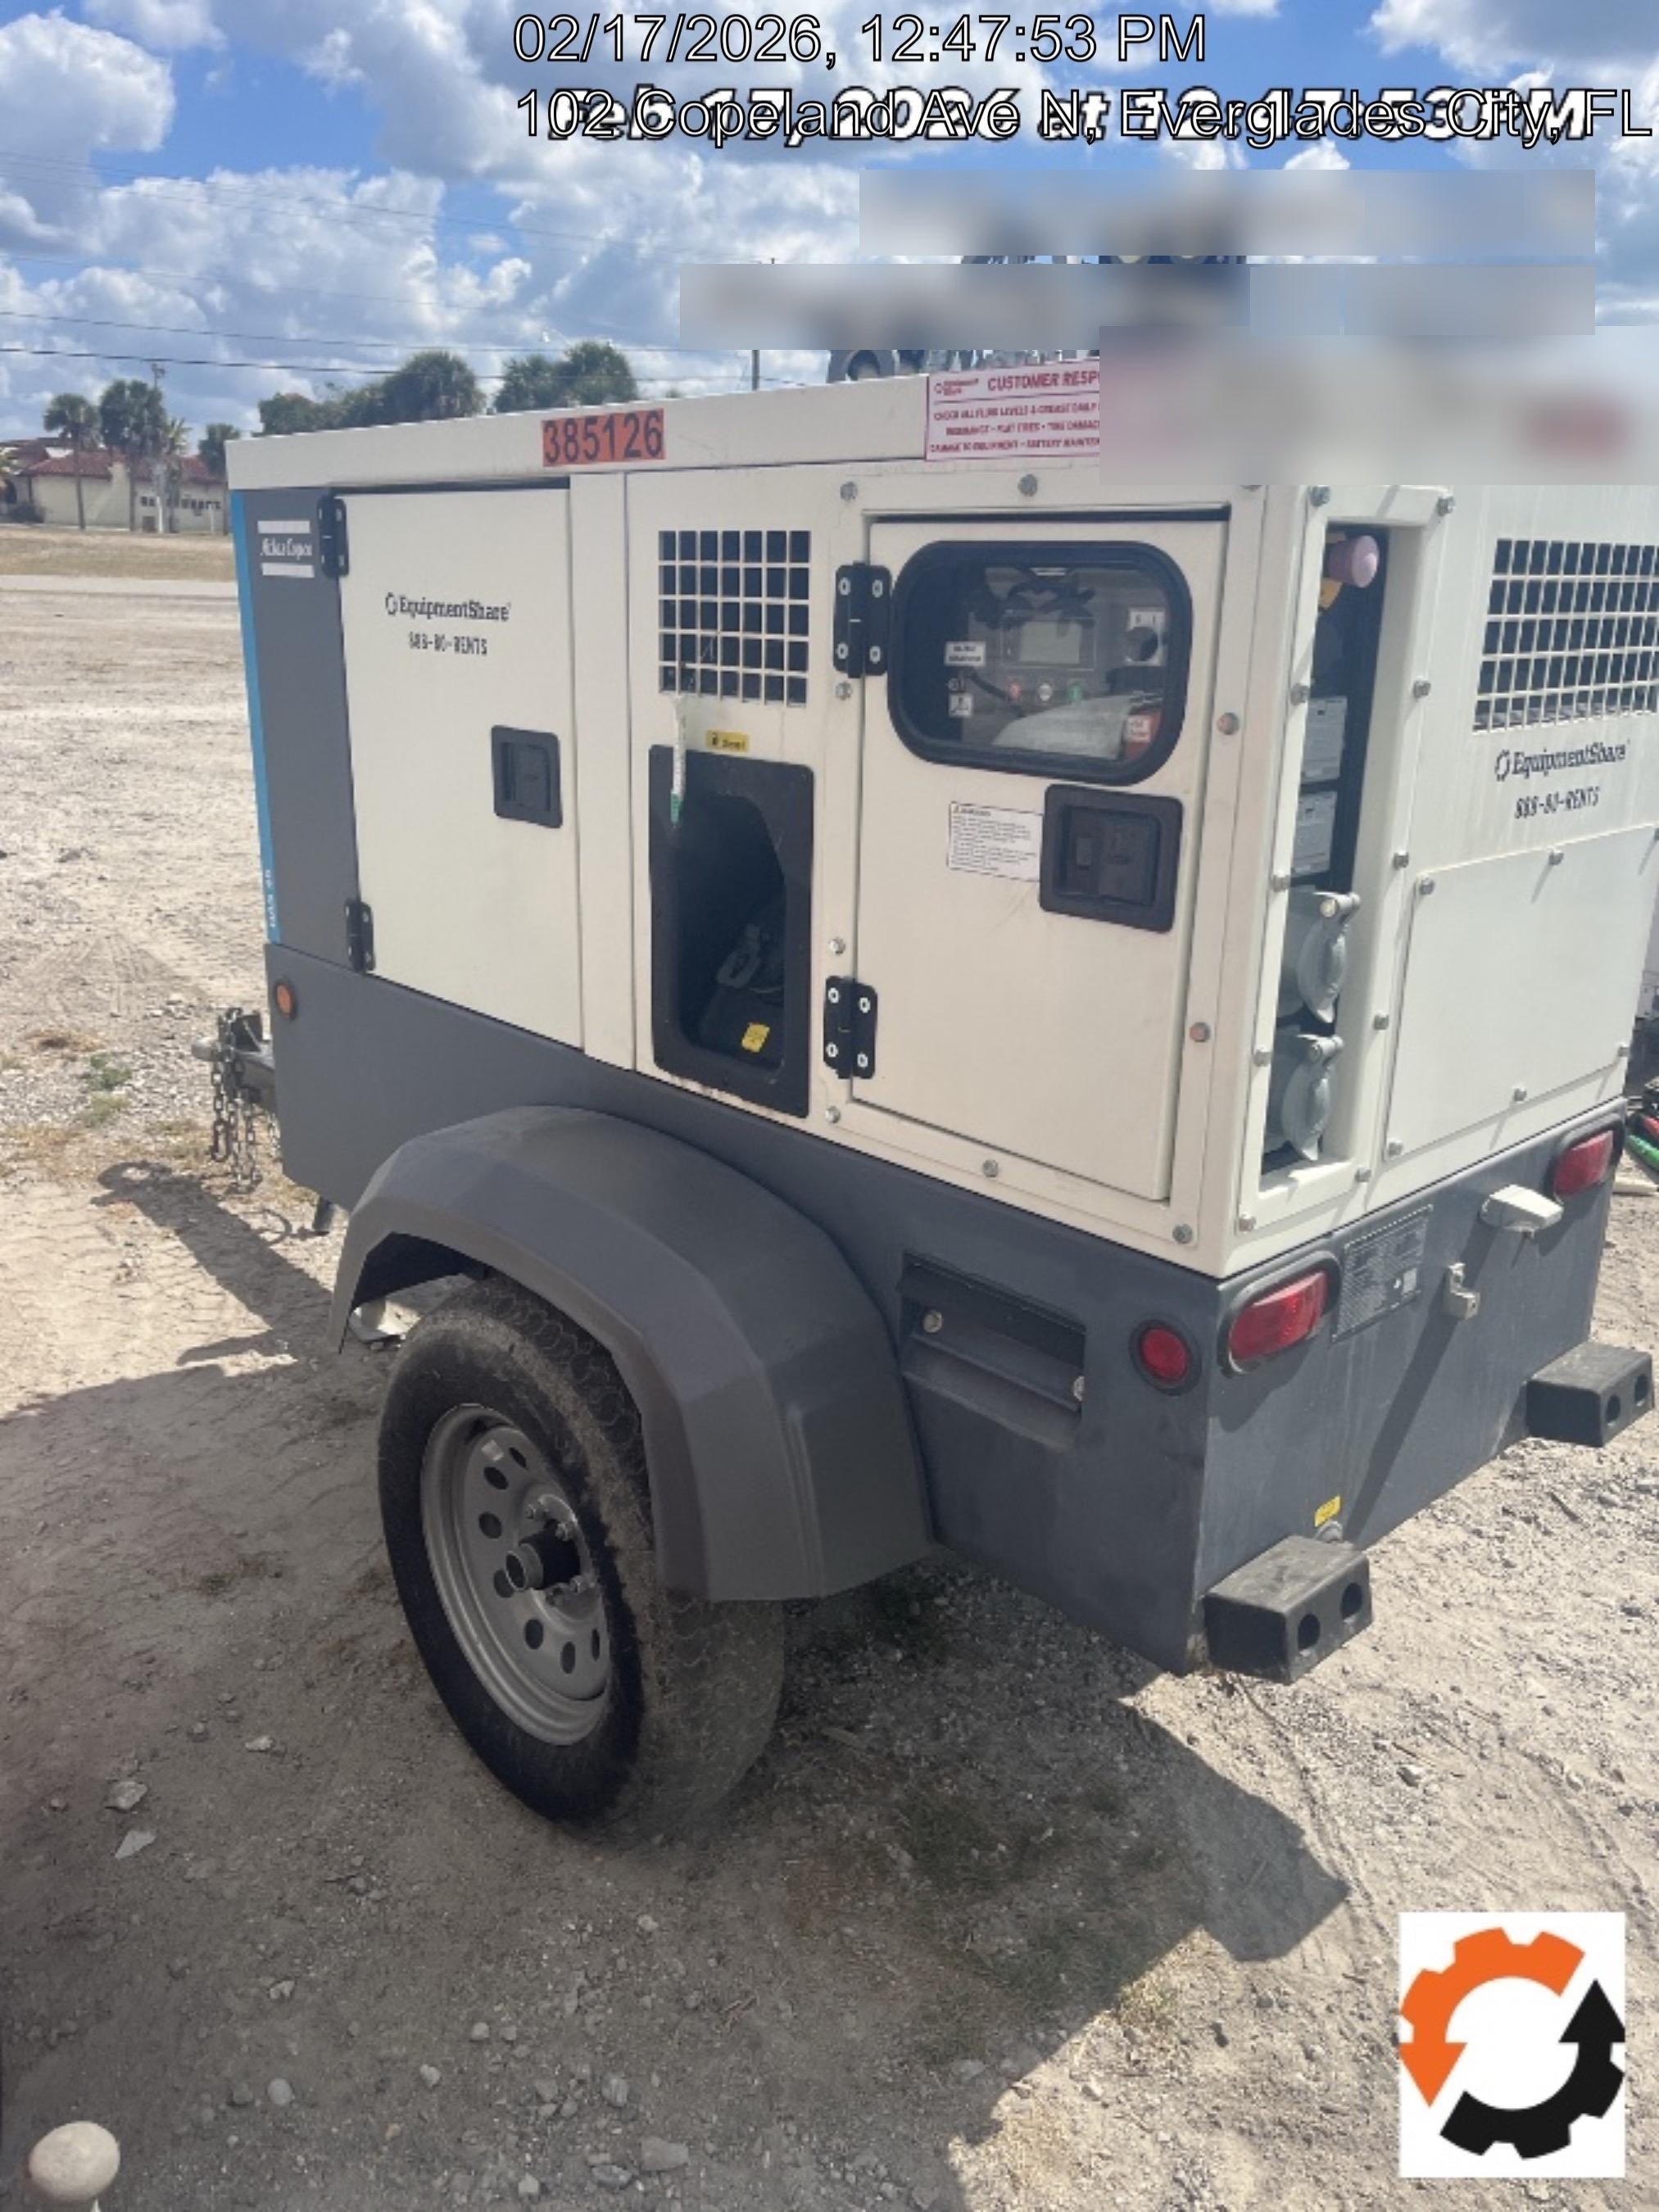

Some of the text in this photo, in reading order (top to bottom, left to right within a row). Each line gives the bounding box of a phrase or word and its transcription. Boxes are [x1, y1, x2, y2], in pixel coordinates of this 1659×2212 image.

[987, 373, 1060, 392] CUSTOMER
[1062, 370, 1099, 387] RESP
[544, 410, 663, 464] 385126
[399, 596, 510, 623] EquipmentShare
[1512, 741, 1627, 780] EquipmentShare
